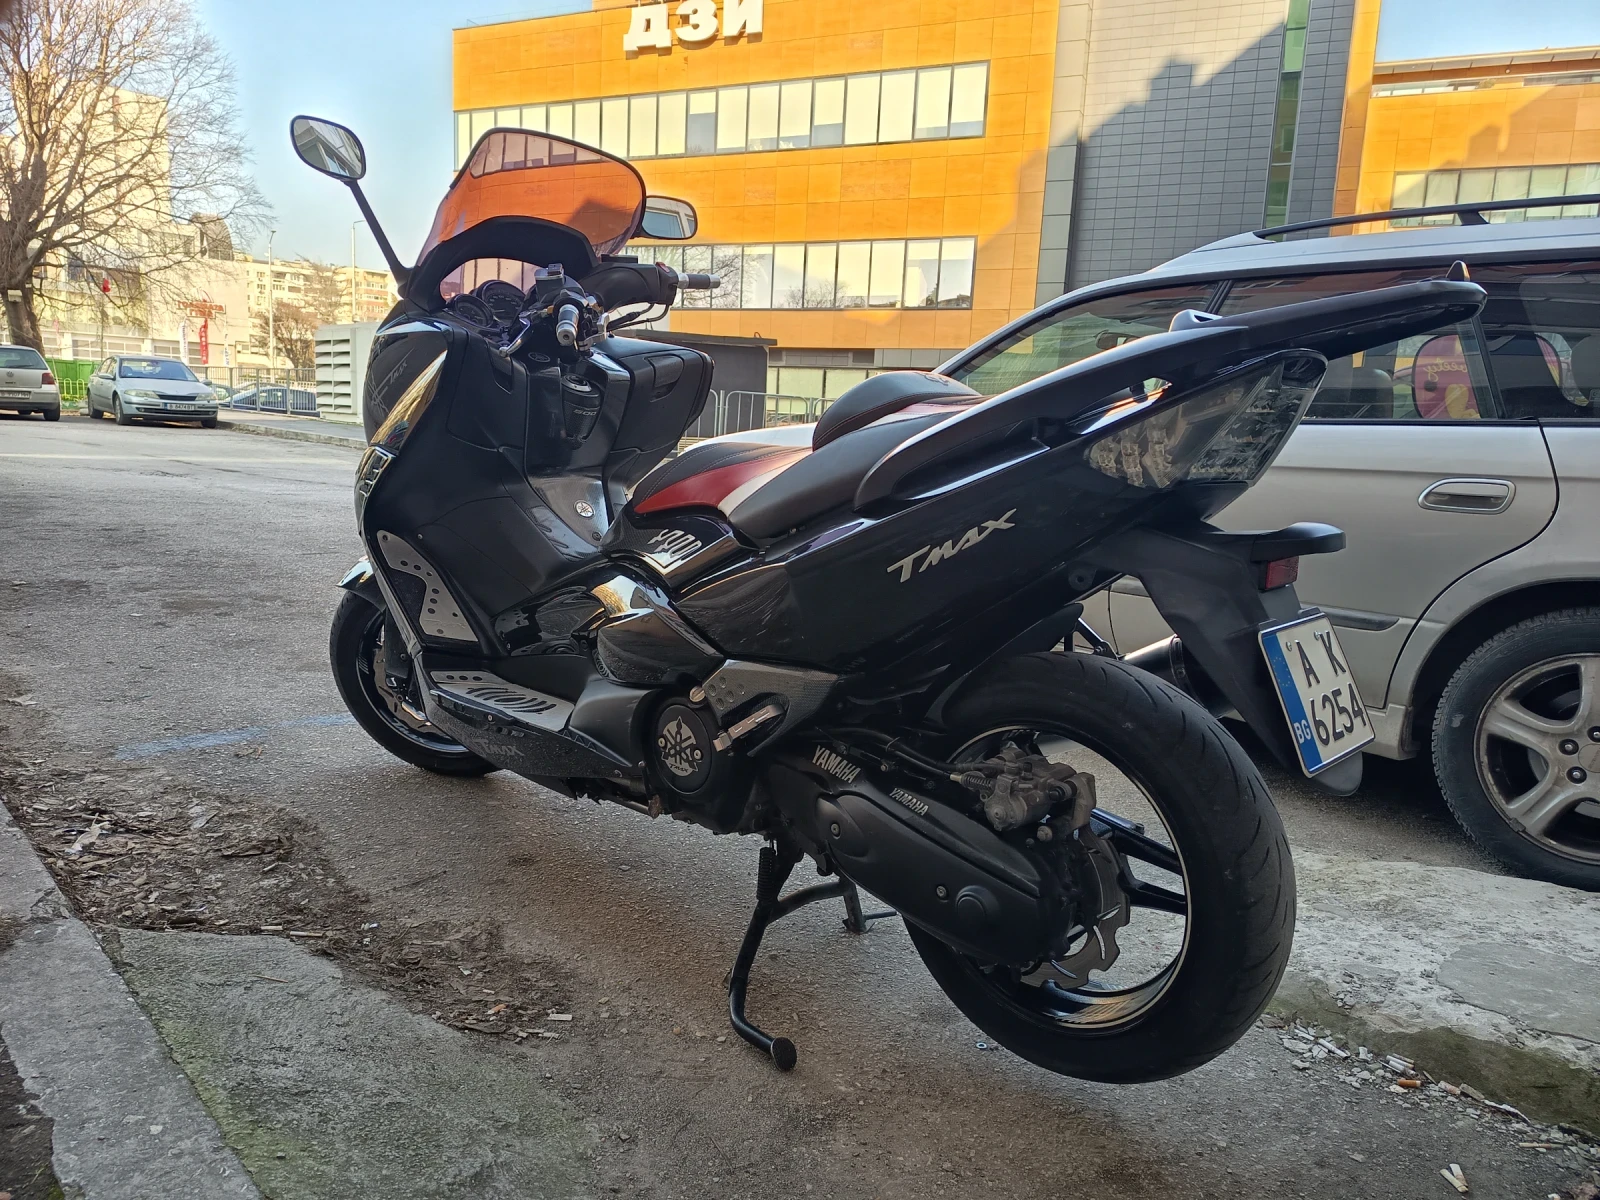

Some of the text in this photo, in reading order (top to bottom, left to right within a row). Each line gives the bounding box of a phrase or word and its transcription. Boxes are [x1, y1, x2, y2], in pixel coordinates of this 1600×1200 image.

[623, 0, 764, 56] ДЗИ
[886, 508, 1017, 583] TMAX
[1294, 630, 1347, 688] A K
[1293, 719, 1312, 744] BG
[1309, 682, 1367, 746] 6254
[812, 745, 861, 784] YAMAHA
[889, 787, 929, 816] YAMAHA
